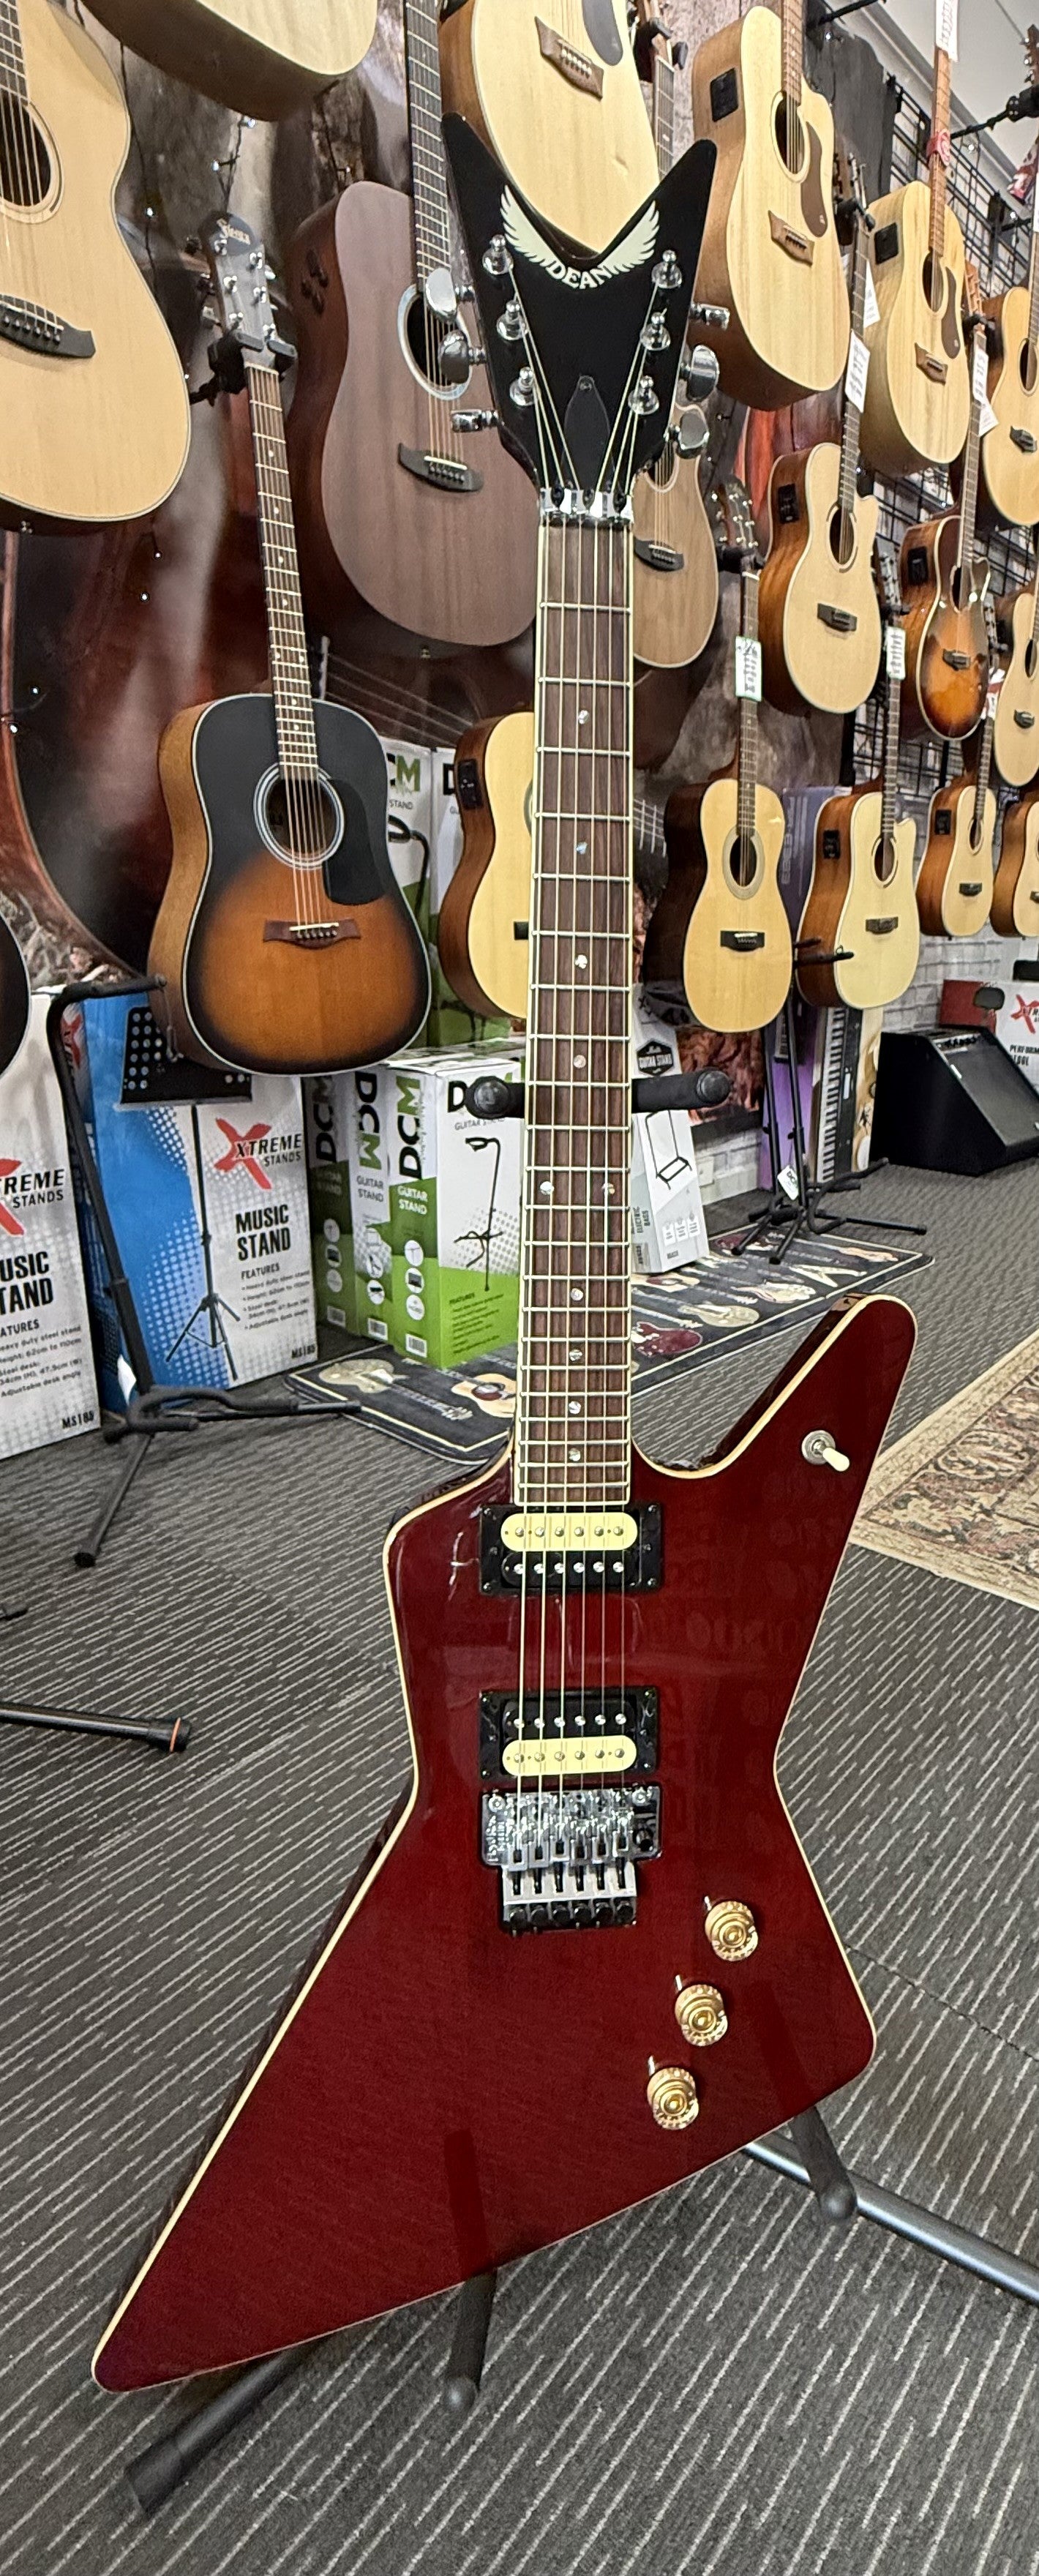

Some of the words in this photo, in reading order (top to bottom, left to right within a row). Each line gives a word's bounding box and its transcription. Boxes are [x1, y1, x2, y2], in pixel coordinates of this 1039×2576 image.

[545, 261, 613, 290] DEAN
[389, 798, 413, 810] STAND
[355, 1071, 382, 1170] DCM
[396, 1075, 422, 1180] DCM
[264, 1150, 301, 1167] STANDS
[0, 1169, 64, 1196] REME
[356, 1175, 384, 1188] GUITAR
[13, 1189, 64, 1208] STANDS
[358, 1188, 384, 1202] STAND
[397, 1186, 428, 1202] GUITAR
[399, 1199, 428, 1216] STAND
[236, 1204, 289, 1234] MUSIC
[237, 1227, 291, 1261] STAND
[0, 1251, 49, 1282] USIC
[241, 1262, 280, 1280] FEATURES
[0, 1278, 53, 1316] TAND
[0, 1319, 40, 1338] ATURES
